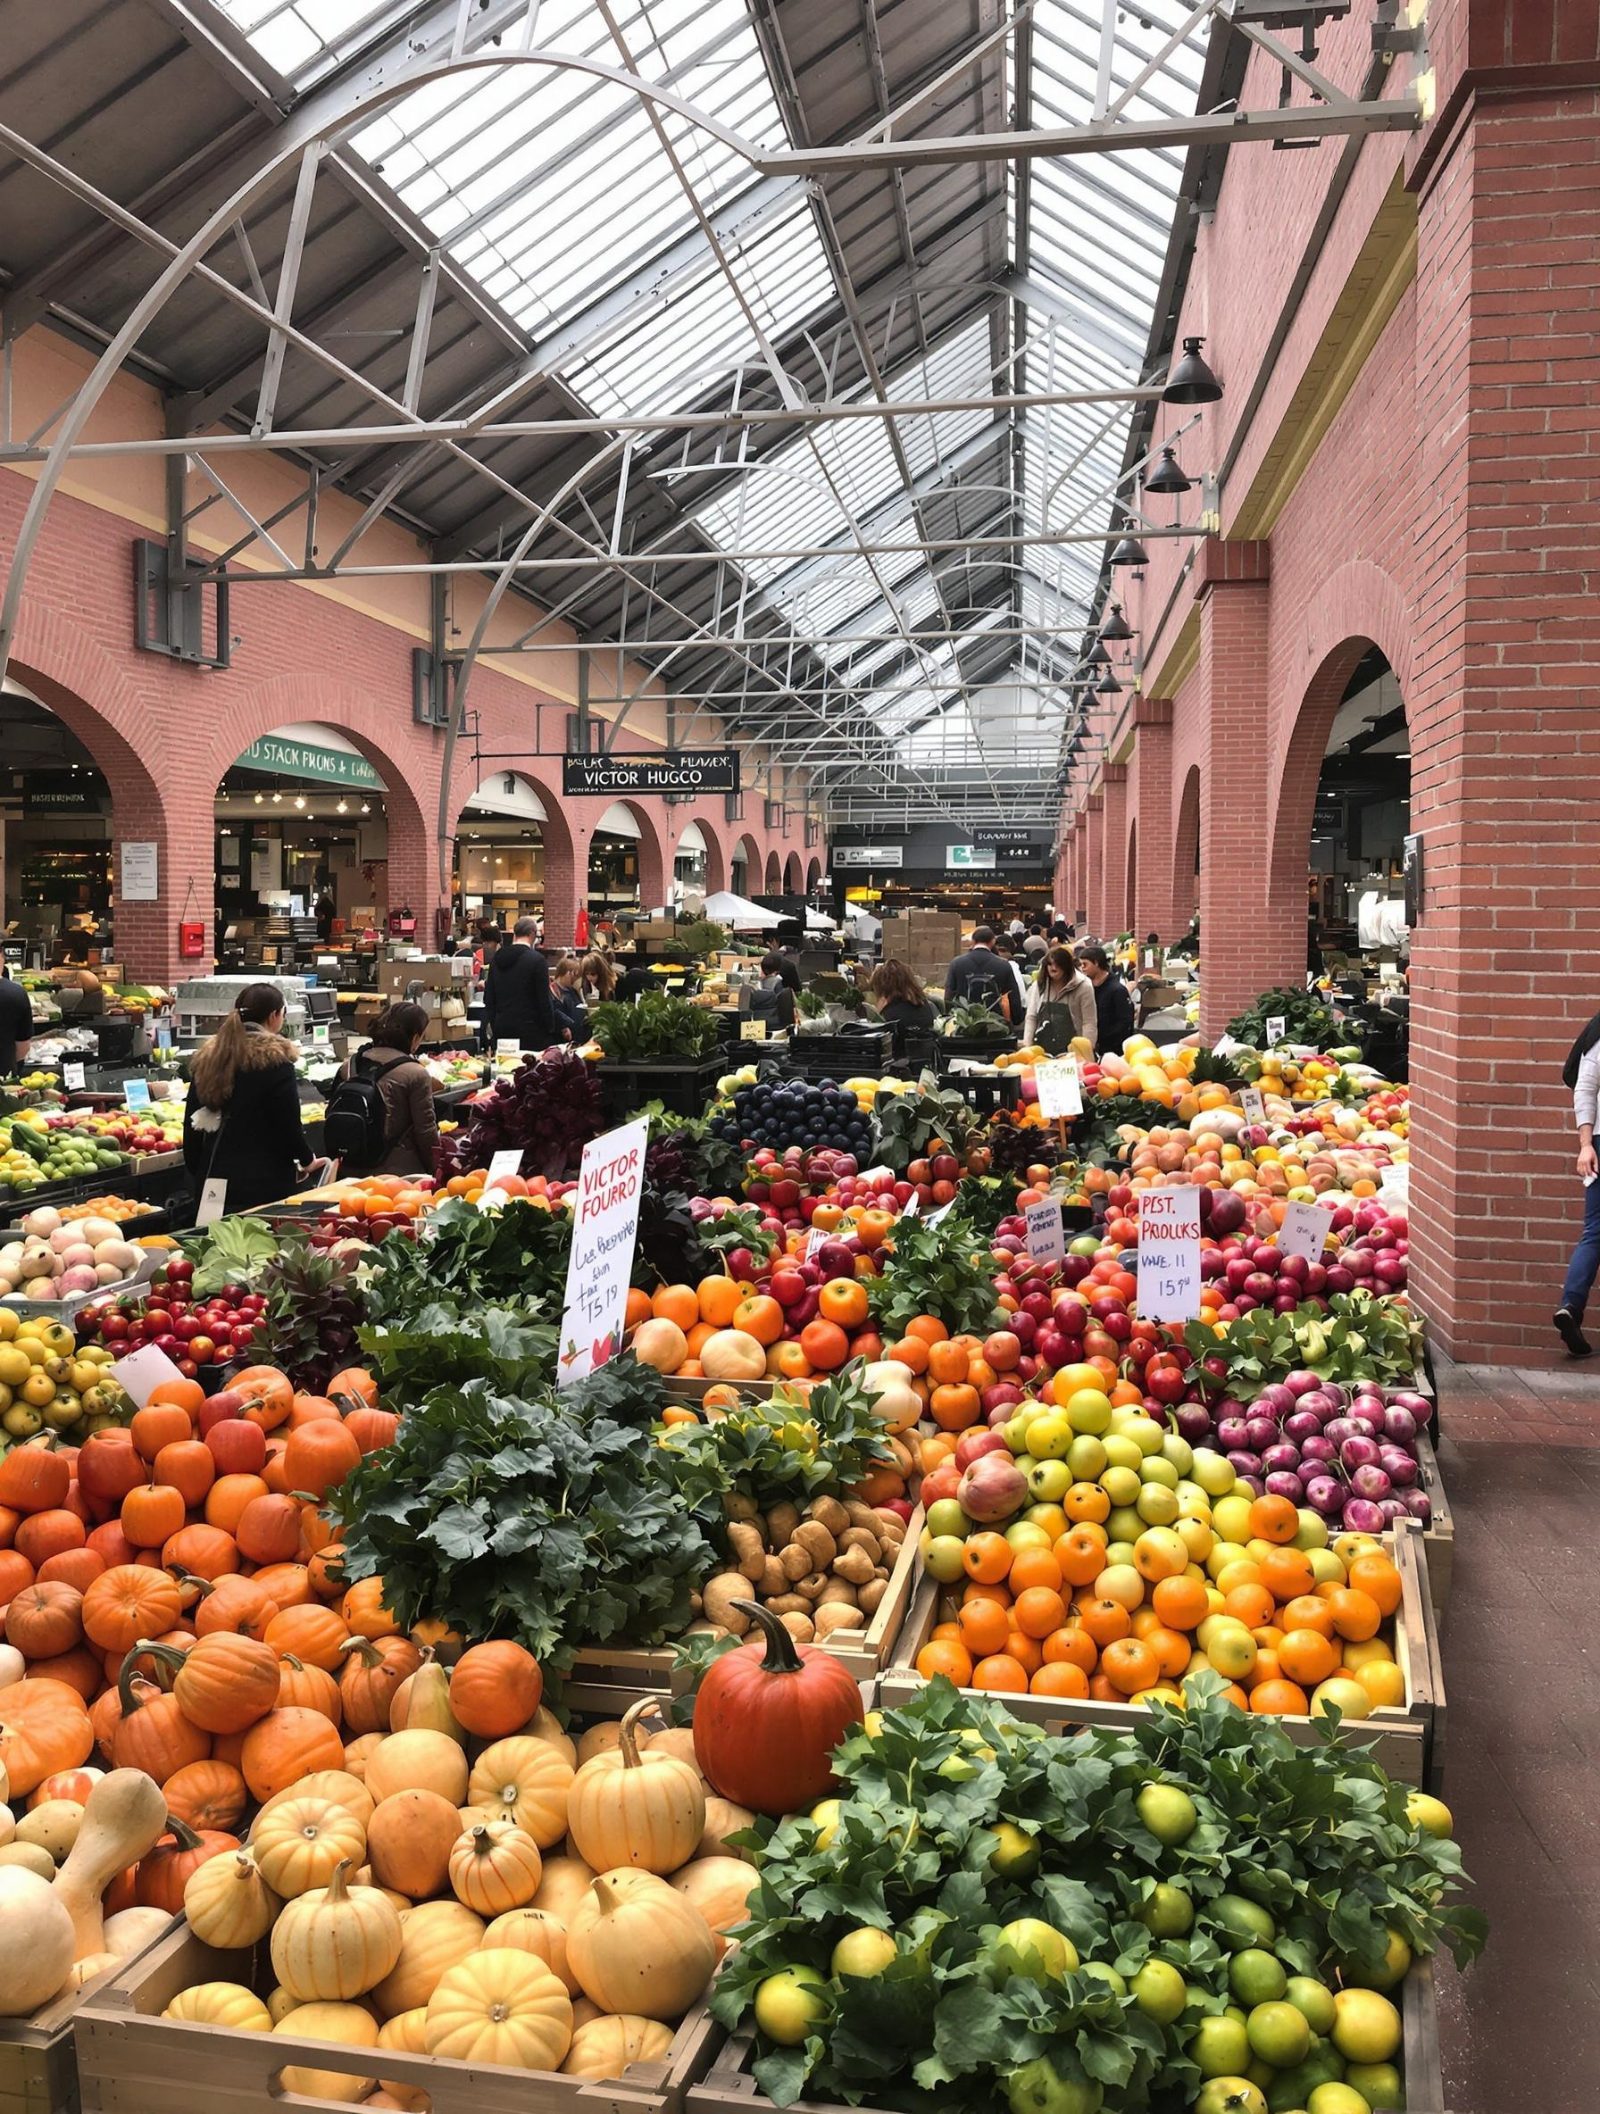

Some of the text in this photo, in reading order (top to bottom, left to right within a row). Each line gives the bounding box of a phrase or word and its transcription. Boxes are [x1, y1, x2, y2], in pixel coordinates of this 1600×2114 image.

[584, 770, 703, 785] VICTOR HUGCO
[584, 1148, 638, 1196] VICTOR
